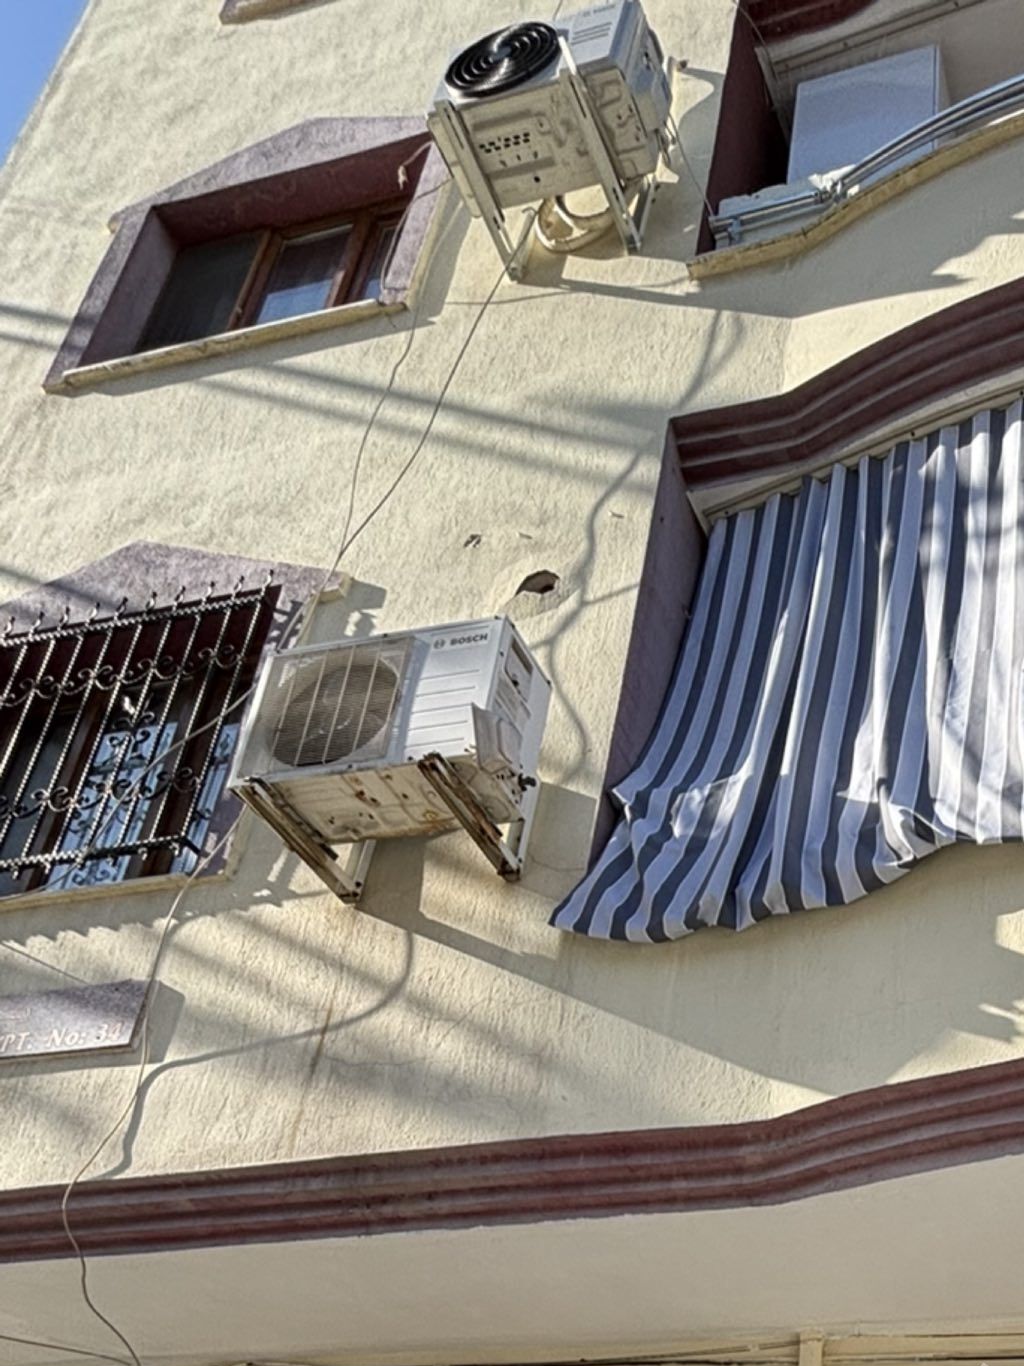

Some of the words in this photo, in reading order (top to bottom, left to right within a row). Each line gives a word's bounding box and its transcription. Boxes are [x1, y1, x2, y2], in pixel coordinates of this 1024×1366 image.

[451, 633, 489, 646] BOSCH
[0, 1031, 33, 1052] PT.
[47, 1028, 87, 1047] No:
[96, 1022, 123, 1041] 34
